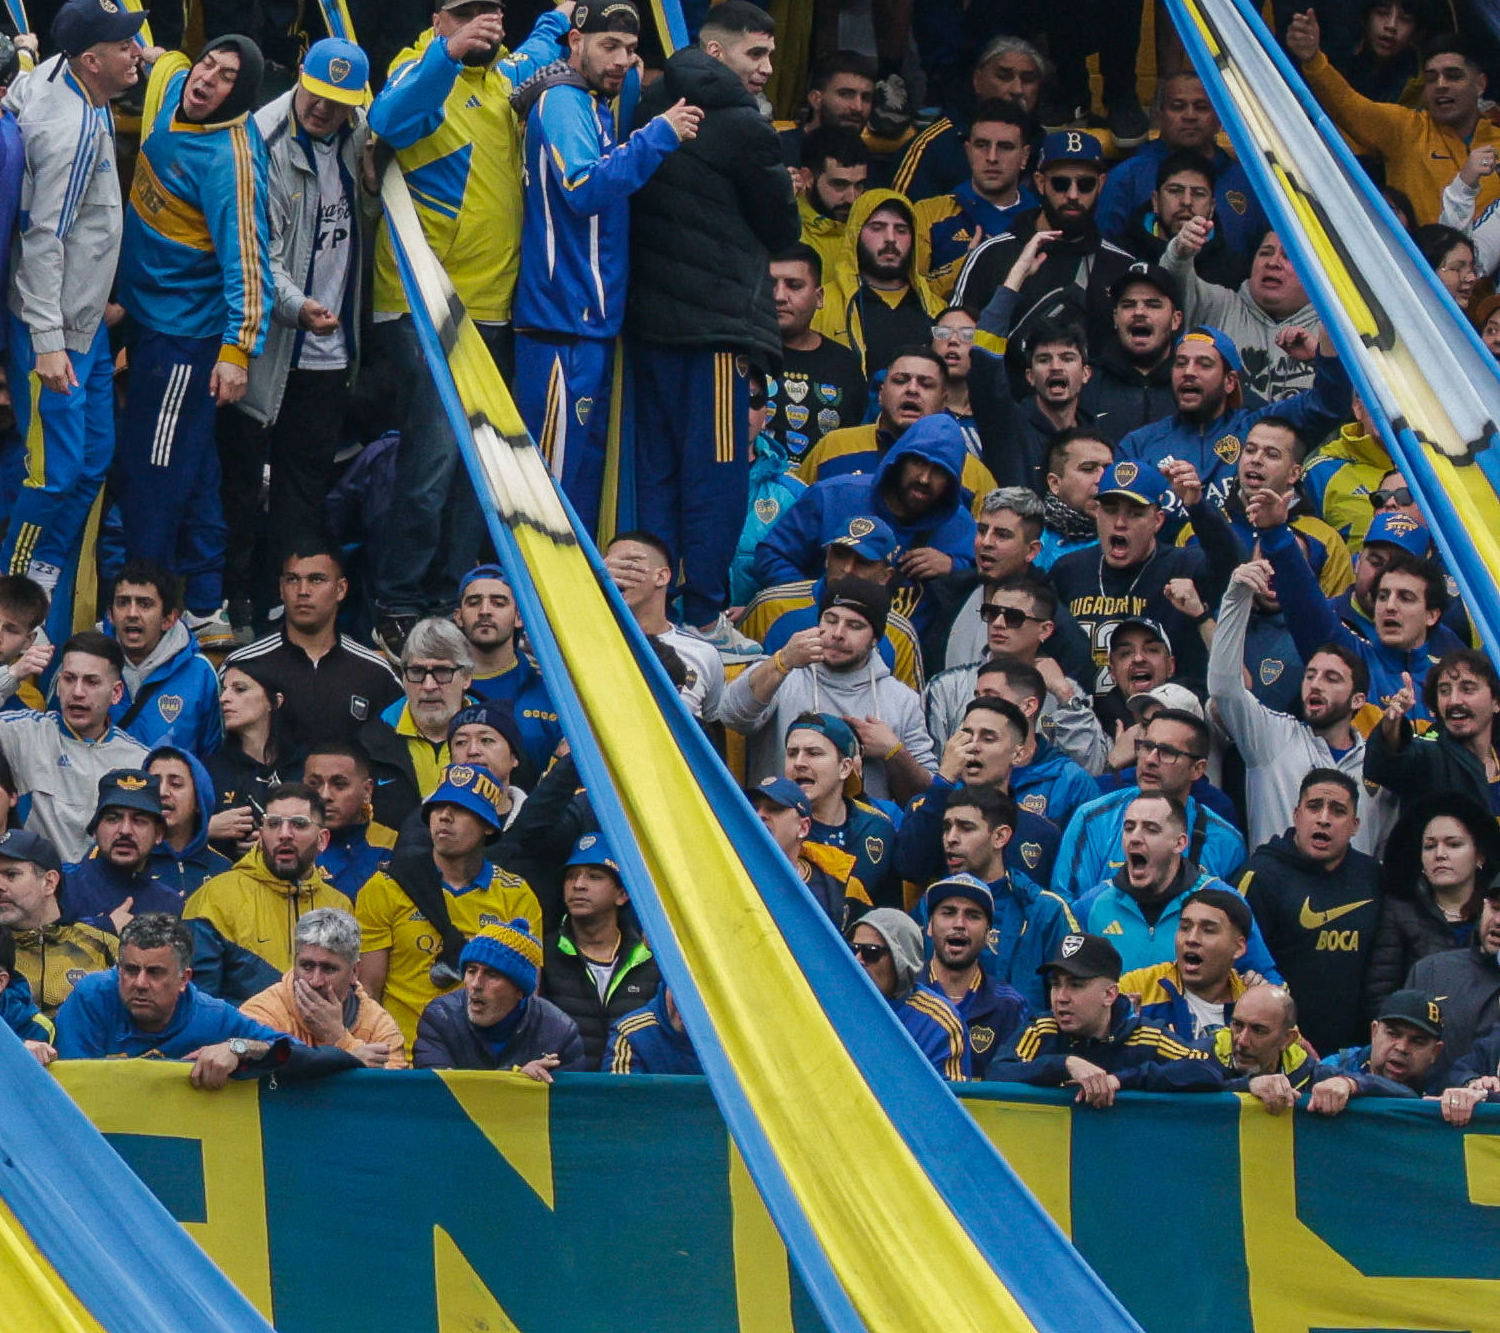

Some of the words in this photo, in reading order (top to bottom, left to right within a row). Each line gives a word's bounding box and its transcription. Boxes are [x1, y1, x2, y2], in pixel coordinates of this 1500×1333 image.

[1067, 132, 1082, 153] B
[1315, 930, 1360, 953] BOCA
[1427, 1001, 1443, 1024] B
